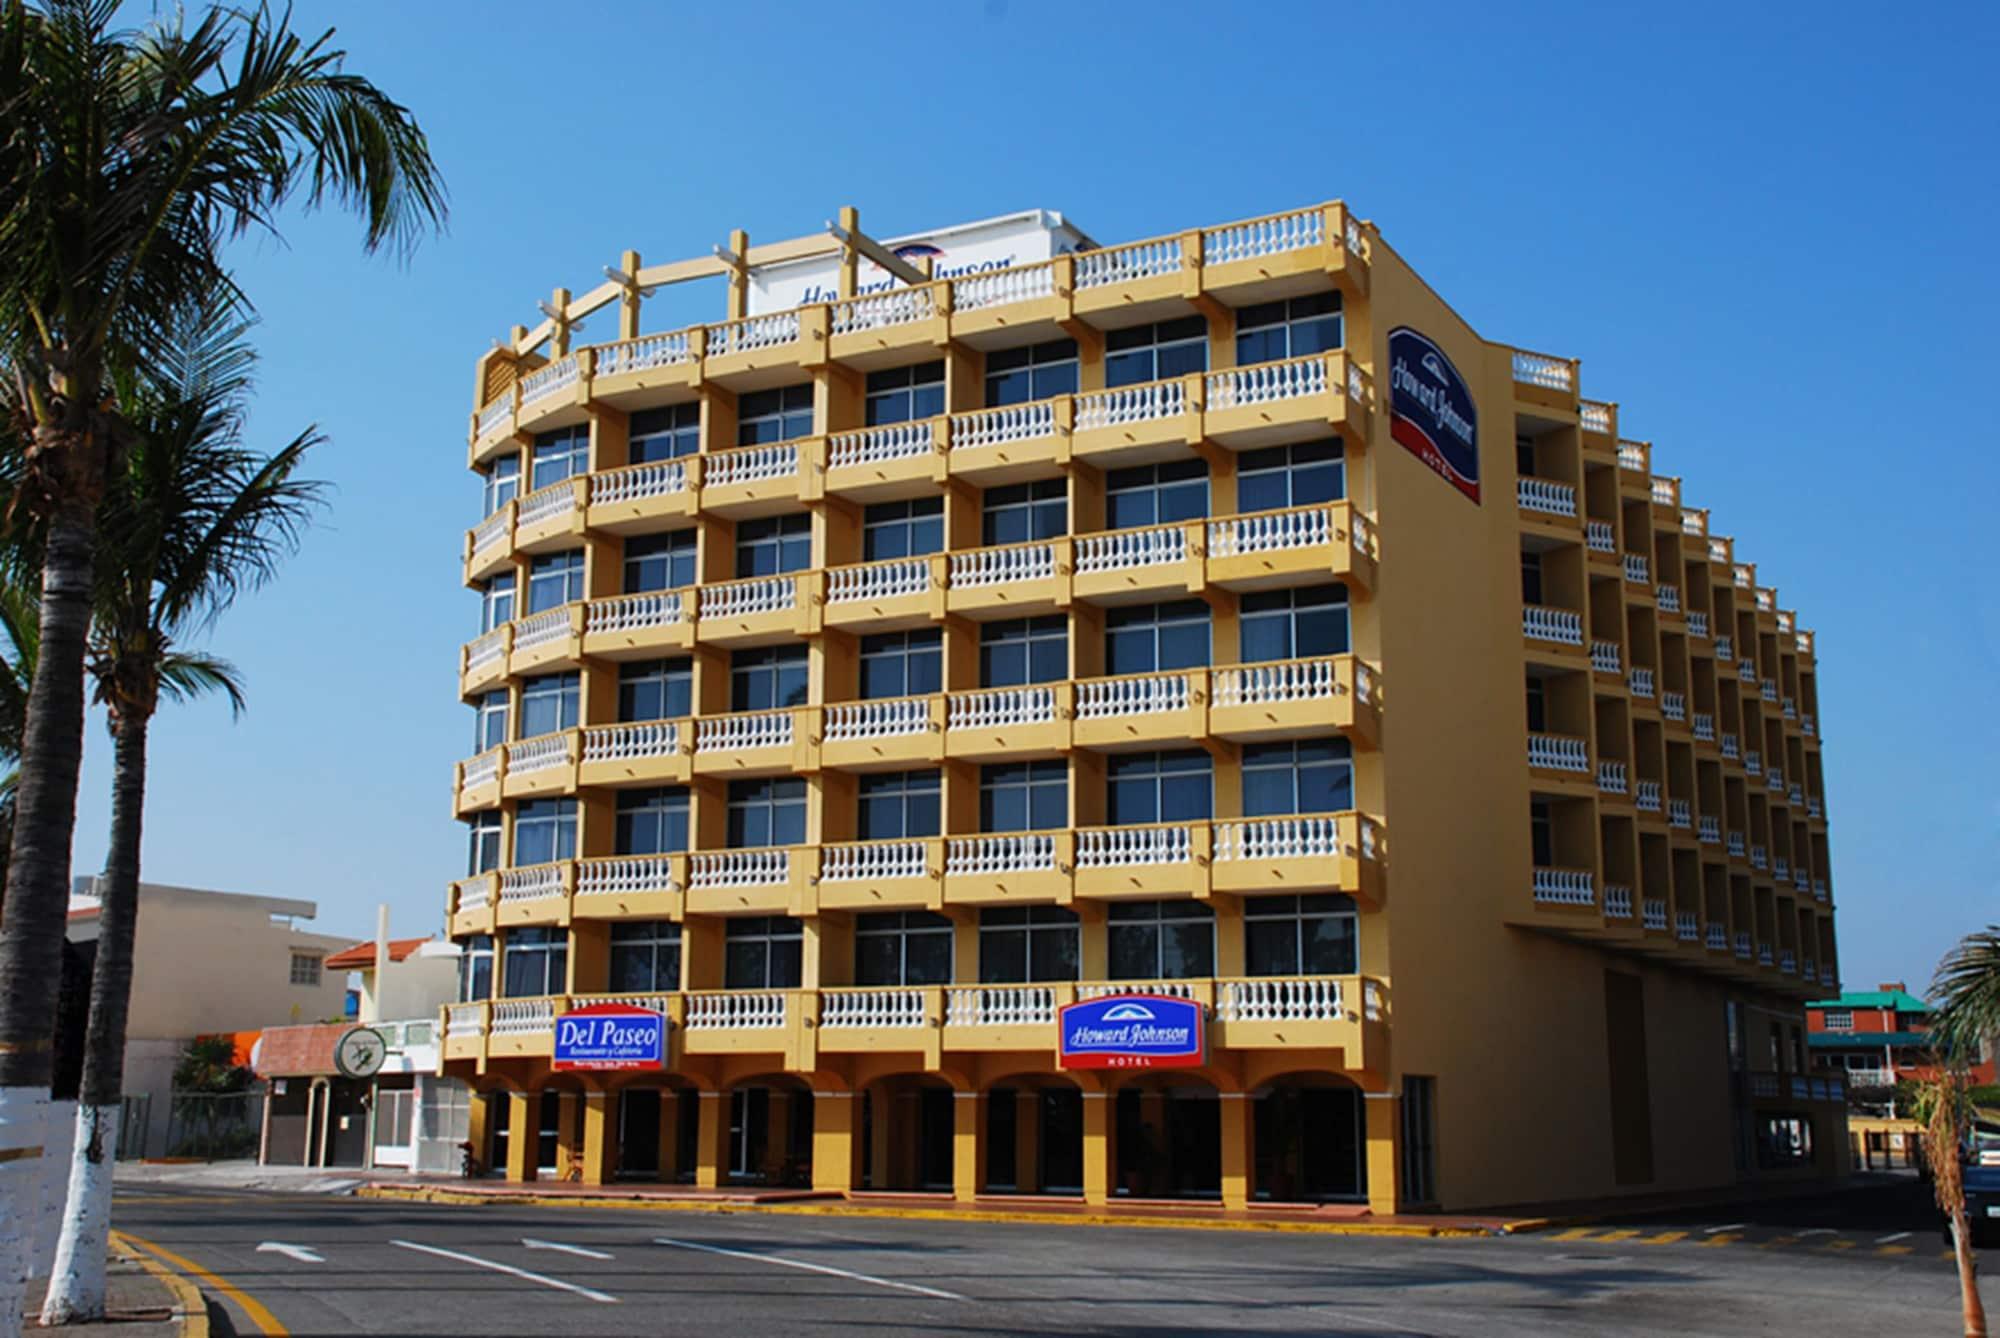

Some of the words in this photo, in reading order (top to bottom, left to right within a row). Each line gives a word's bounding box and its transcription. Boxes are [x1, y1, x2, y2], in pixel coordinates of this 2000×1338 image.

[560, 1021, 595, 1046] Del
[601, 1020, 656, 1046] Paseo
[1070, 1026, 1129, 1046] Howard
[1128, 1024, 1189, 1048] Johnson
[1108, 1058, 1152, 1067] HOTEL
